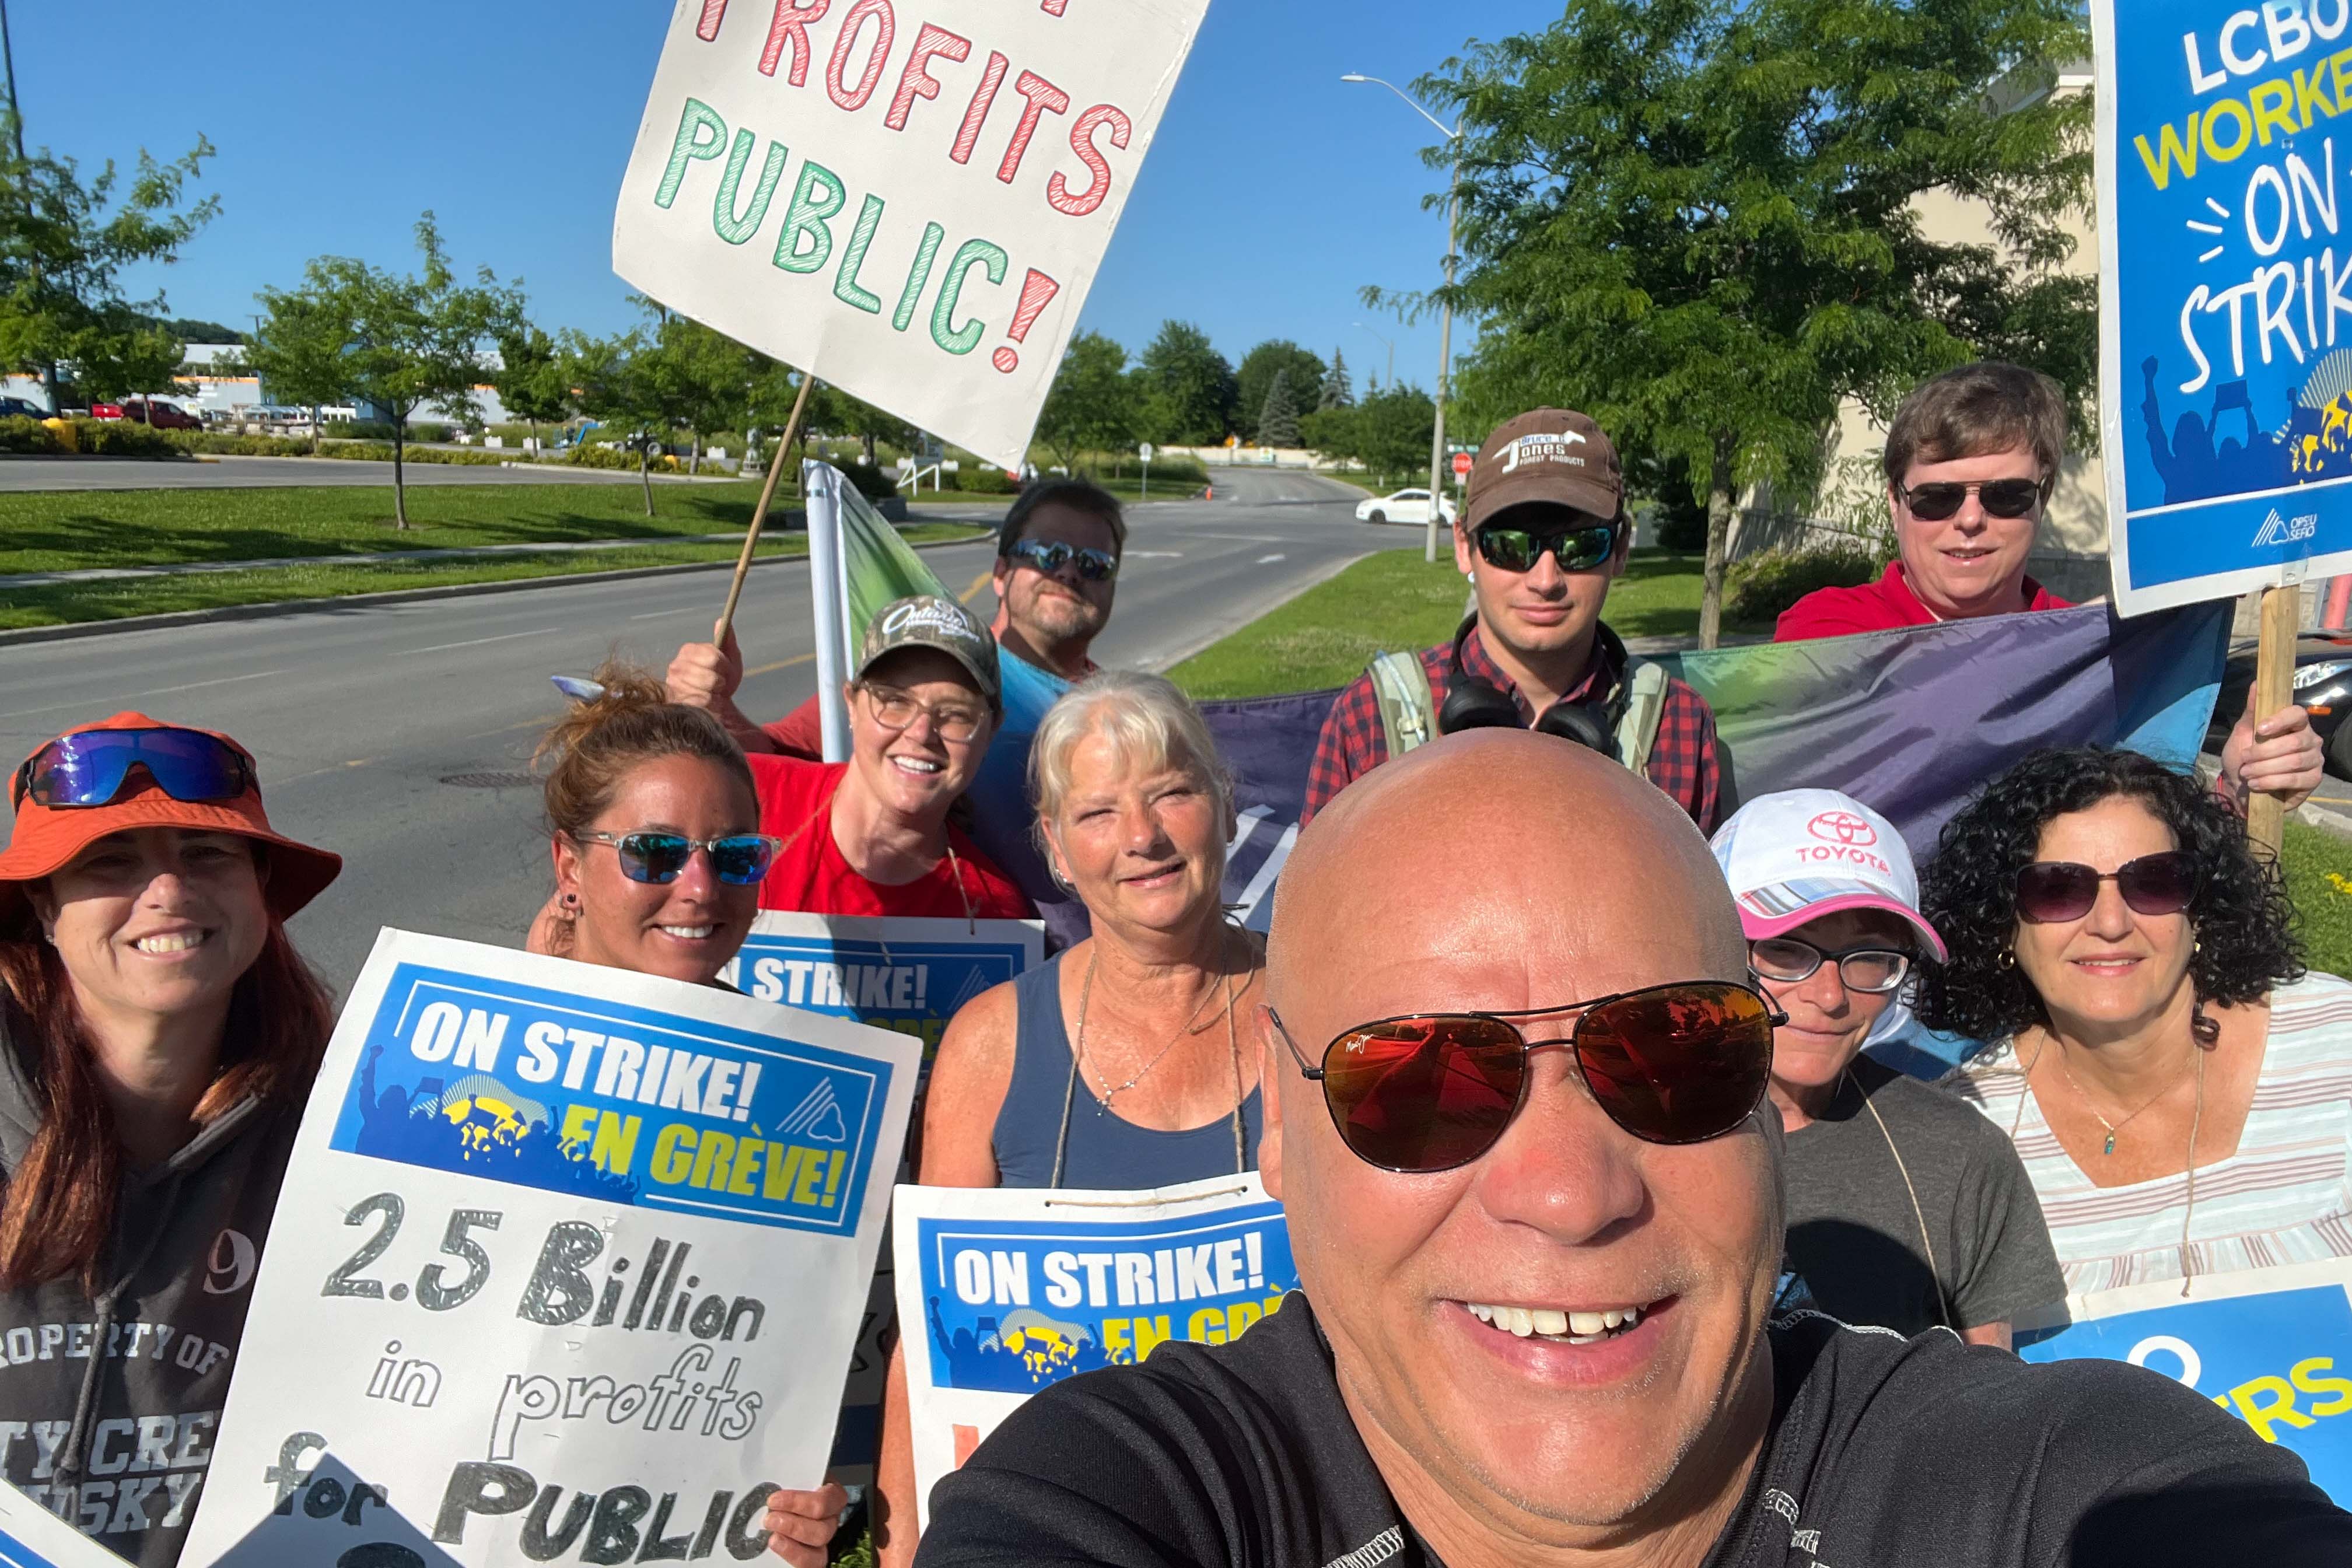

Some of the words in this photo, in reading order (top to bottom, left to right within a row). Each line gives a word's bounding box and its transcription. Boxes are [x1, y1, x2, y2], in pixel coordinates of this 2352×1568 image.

[2183, 0, 2349, 94] LCBO
[654, 97, 1060, 373] PUBLIC!
[2245, 137, 2337, 256] ON
[1549, 454, 1584, 467] PRODUCTS
[1796, 846, 1891, 876] TOYOTA
[752, 958, 928, 1010] STRIKE!
[410, 1001, 510, 1072] ON
[516, 1021, 762, 1122] STRIKE!
[558, 1103, 642, 1176] EN
[649, 1122, 848, 1208] GRÈVE!
[202, 1228, 256, 1294] 9
[321, 1192, 502, 1311] 2.5
[516, 1220, 765, 1342] Billion
[954, 1250, 1028, 1306] ON
[1044, 1231, 1264, 1308] STRIKE!
[176, 1334, 230, 1375] OF
[1103, 1315, 1170, 1365] EN
[366, 1340, 442, 1407] in
[488, 1343, 763, 1461] profits
[264, 1432, 387, 1526] for
[431, 1461, 783, 1566] PUBLIC
